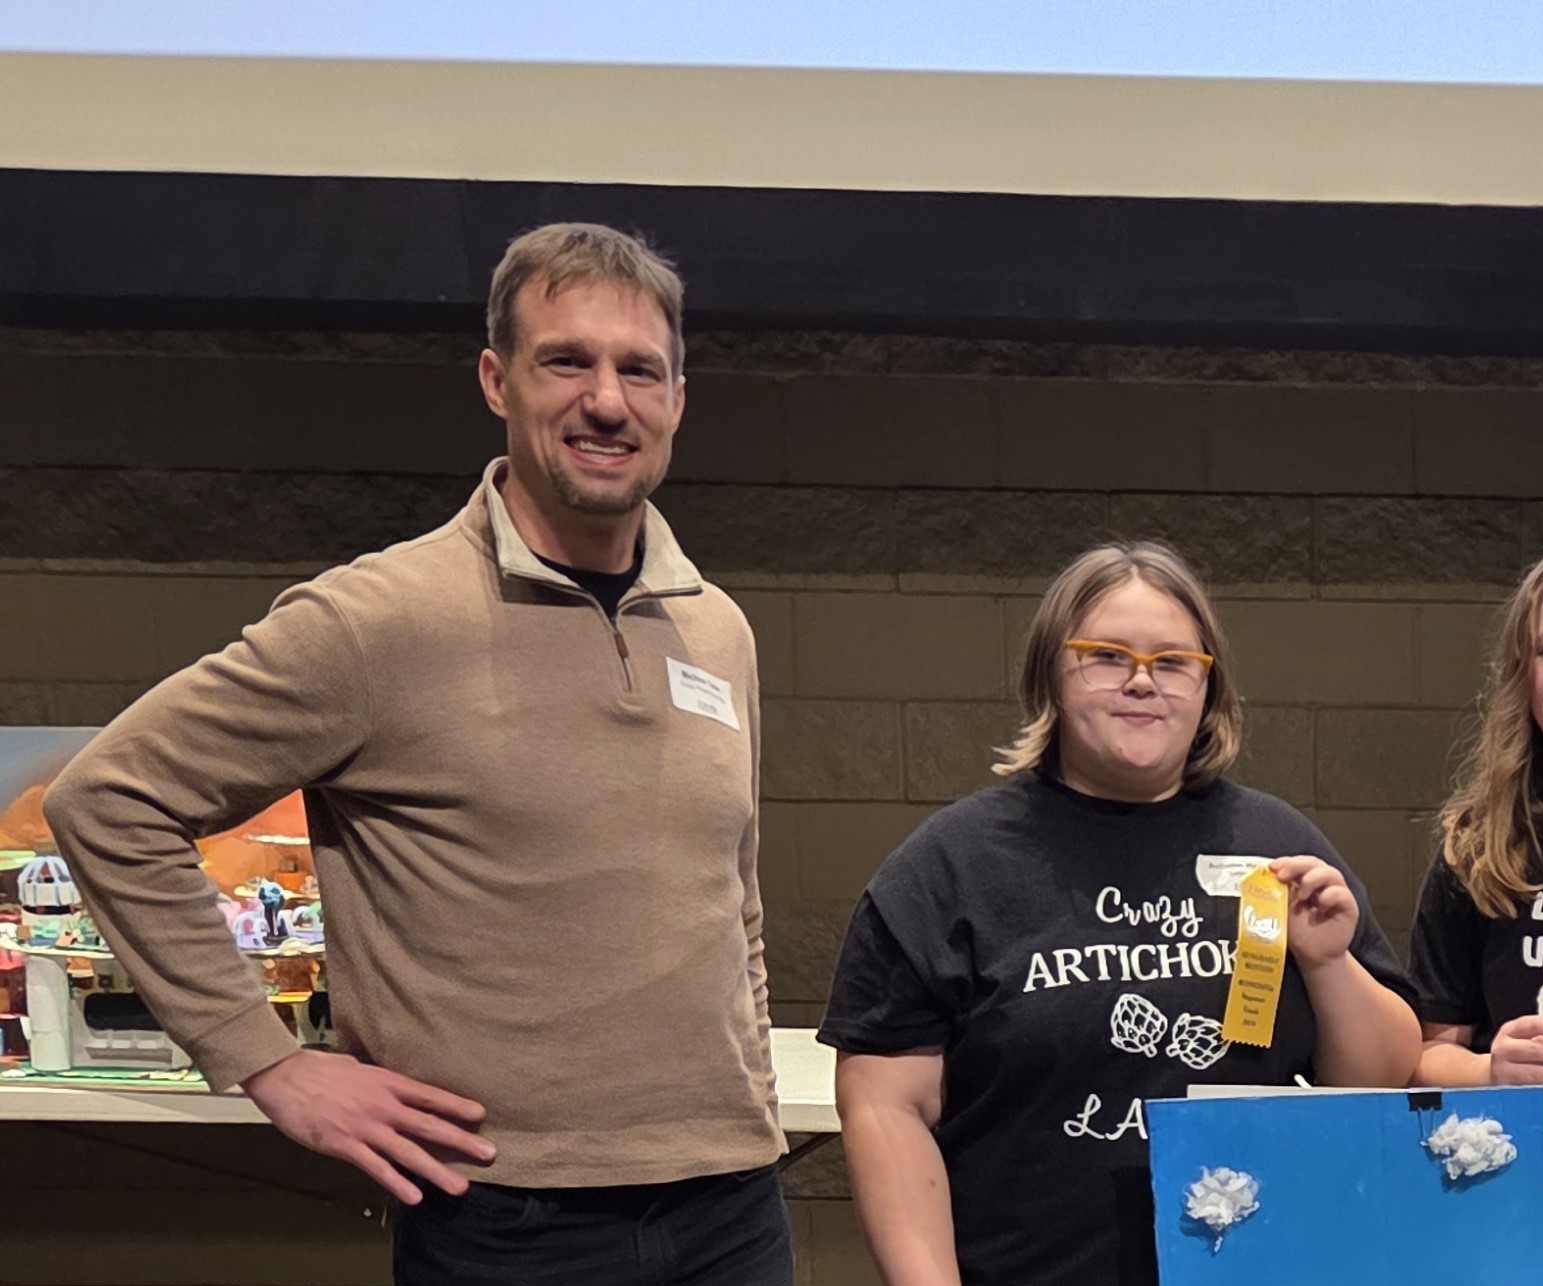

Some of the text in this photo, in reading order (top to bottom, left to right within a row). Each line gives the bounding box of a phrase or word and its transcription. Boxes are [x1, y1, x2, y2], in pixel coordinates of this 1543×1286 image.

[1095, 886, 1204, 938] Crazy
[1023, 939, 1240, 992] ARTICHOK
[1063, 1093, 1149, 1140] LA
